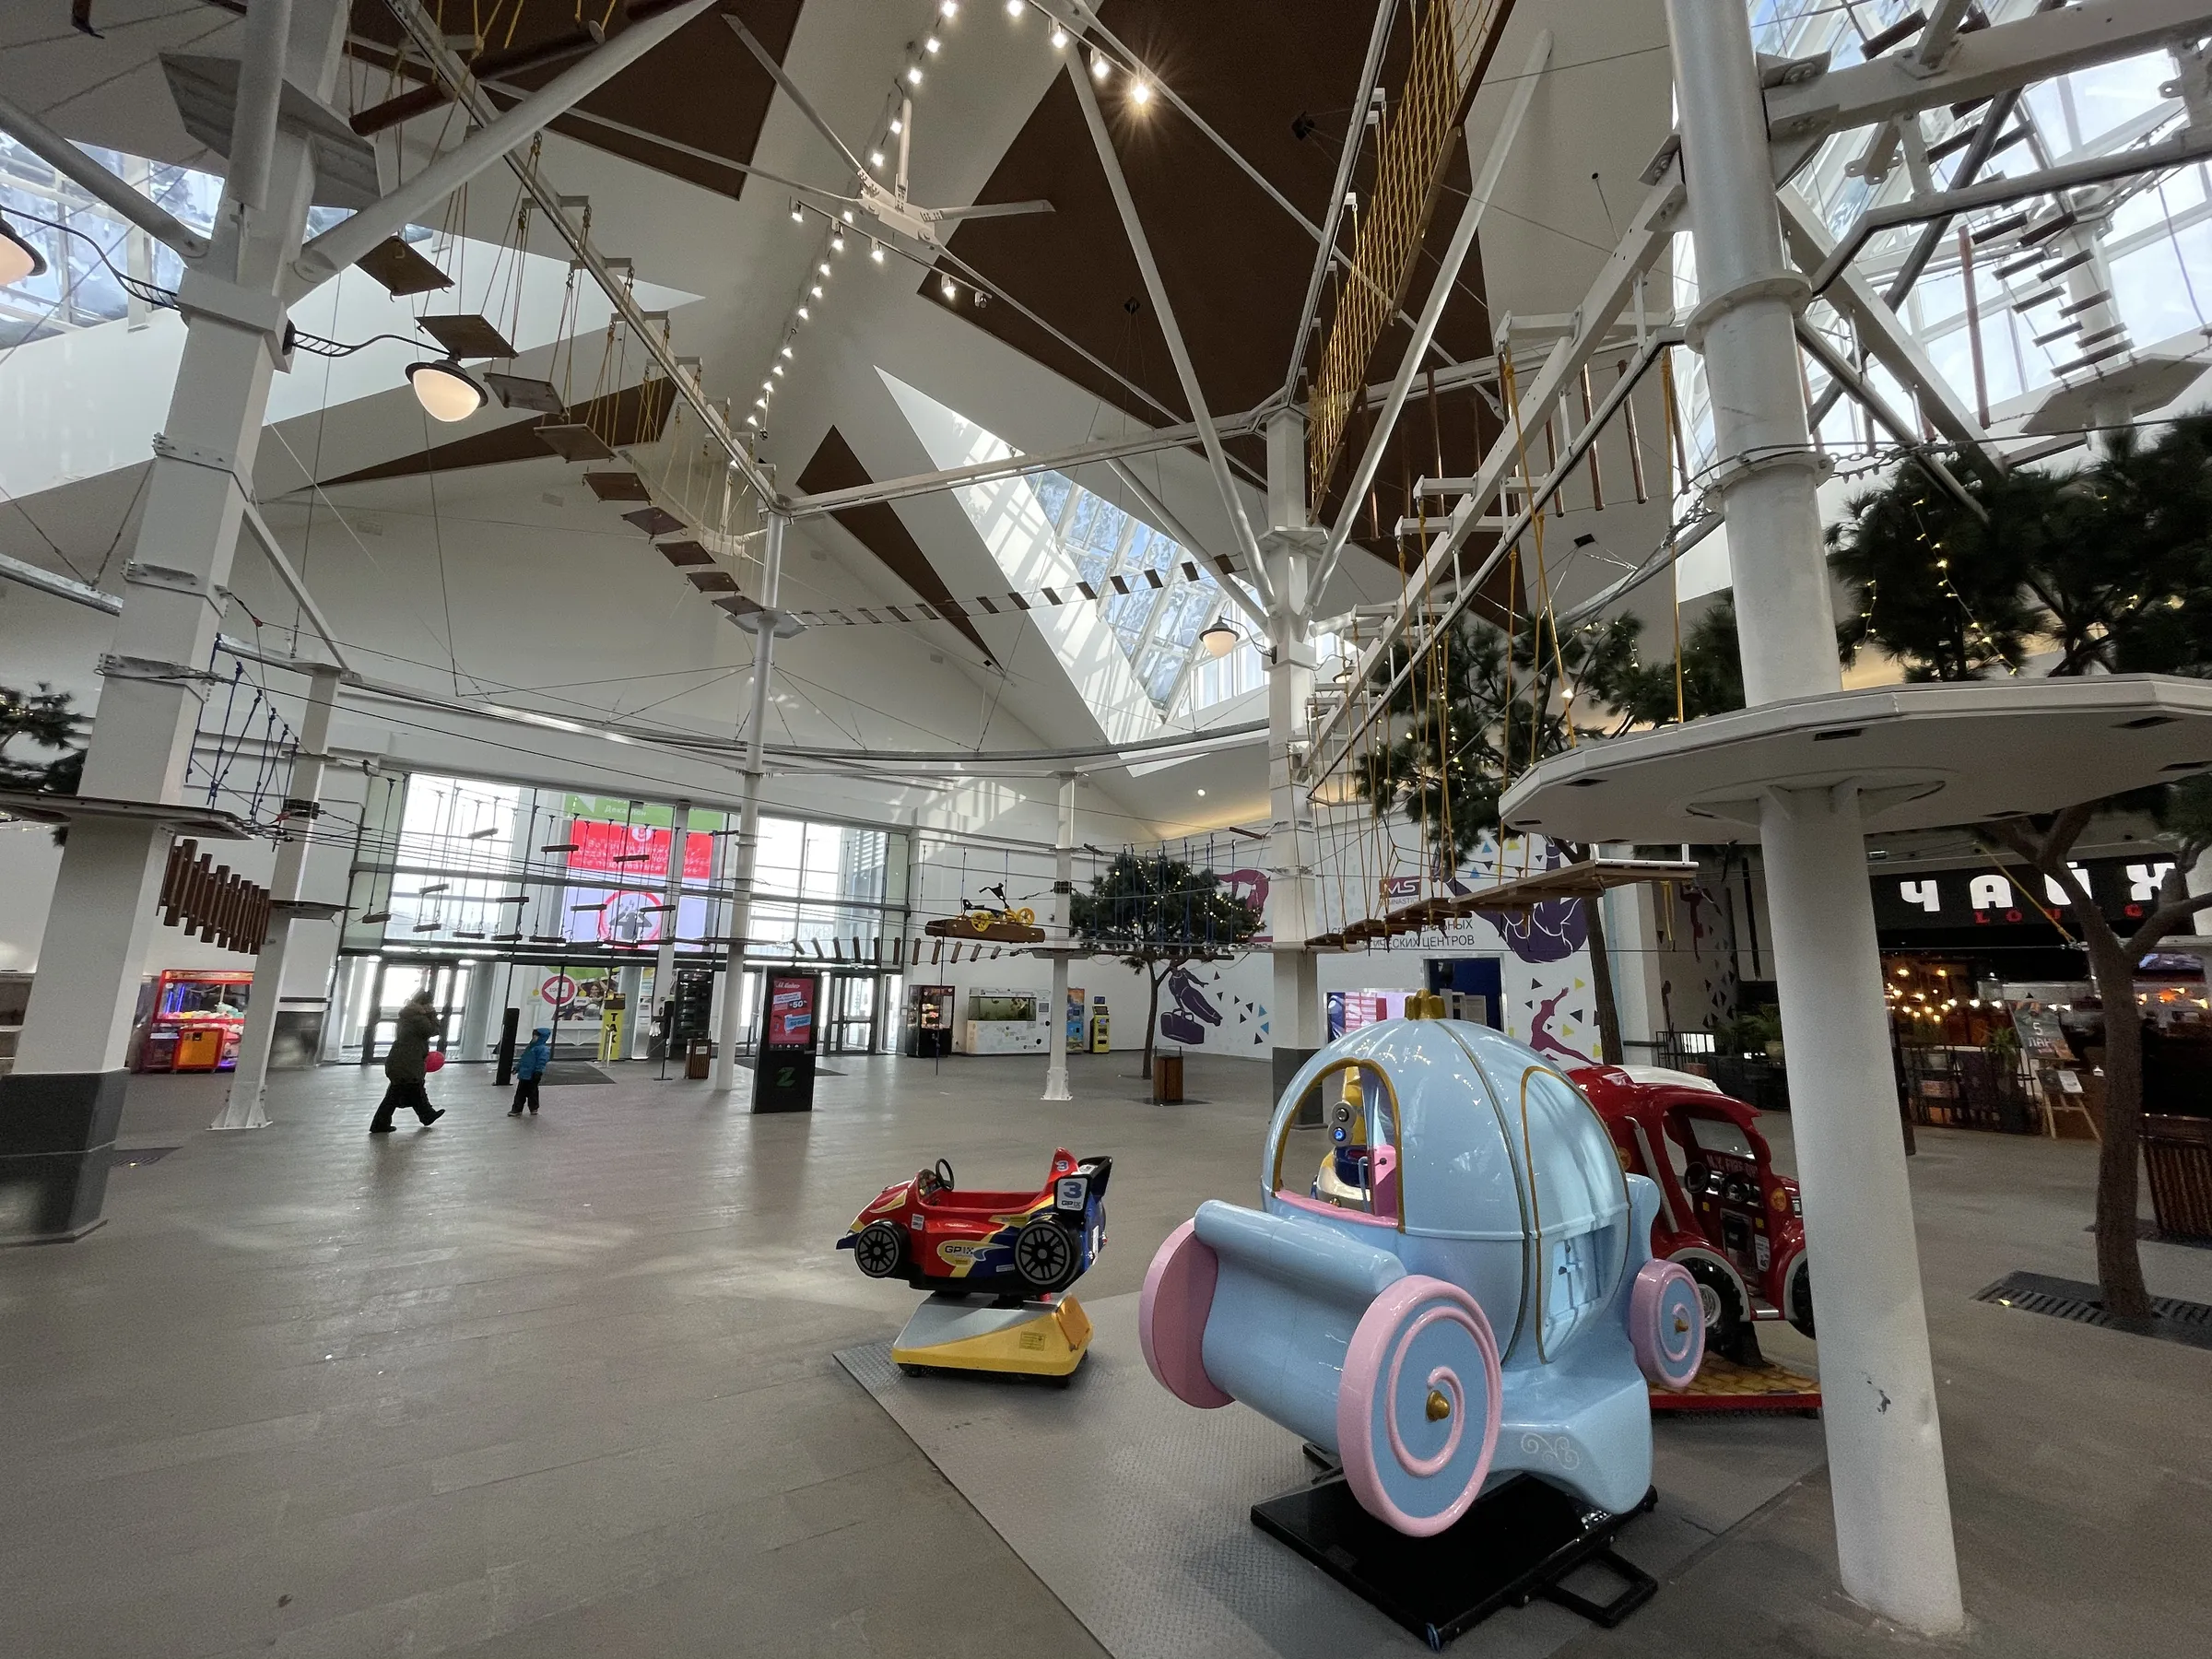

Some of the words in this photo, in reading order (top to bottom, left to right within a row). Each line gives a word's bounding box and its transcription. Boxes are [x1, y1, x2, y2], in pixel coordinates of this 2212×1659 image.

[604, 805, 647, 817] Декалон
[1383, 879, 1420, 895] MS
[1422, 934, 1475, 948] ЦЕНТРОВ
[2032, 1022, 2043, 1036] 5
[1055, 1160, 1069, 1171] 3
[1063, 1181, 1083, 1199] 3
